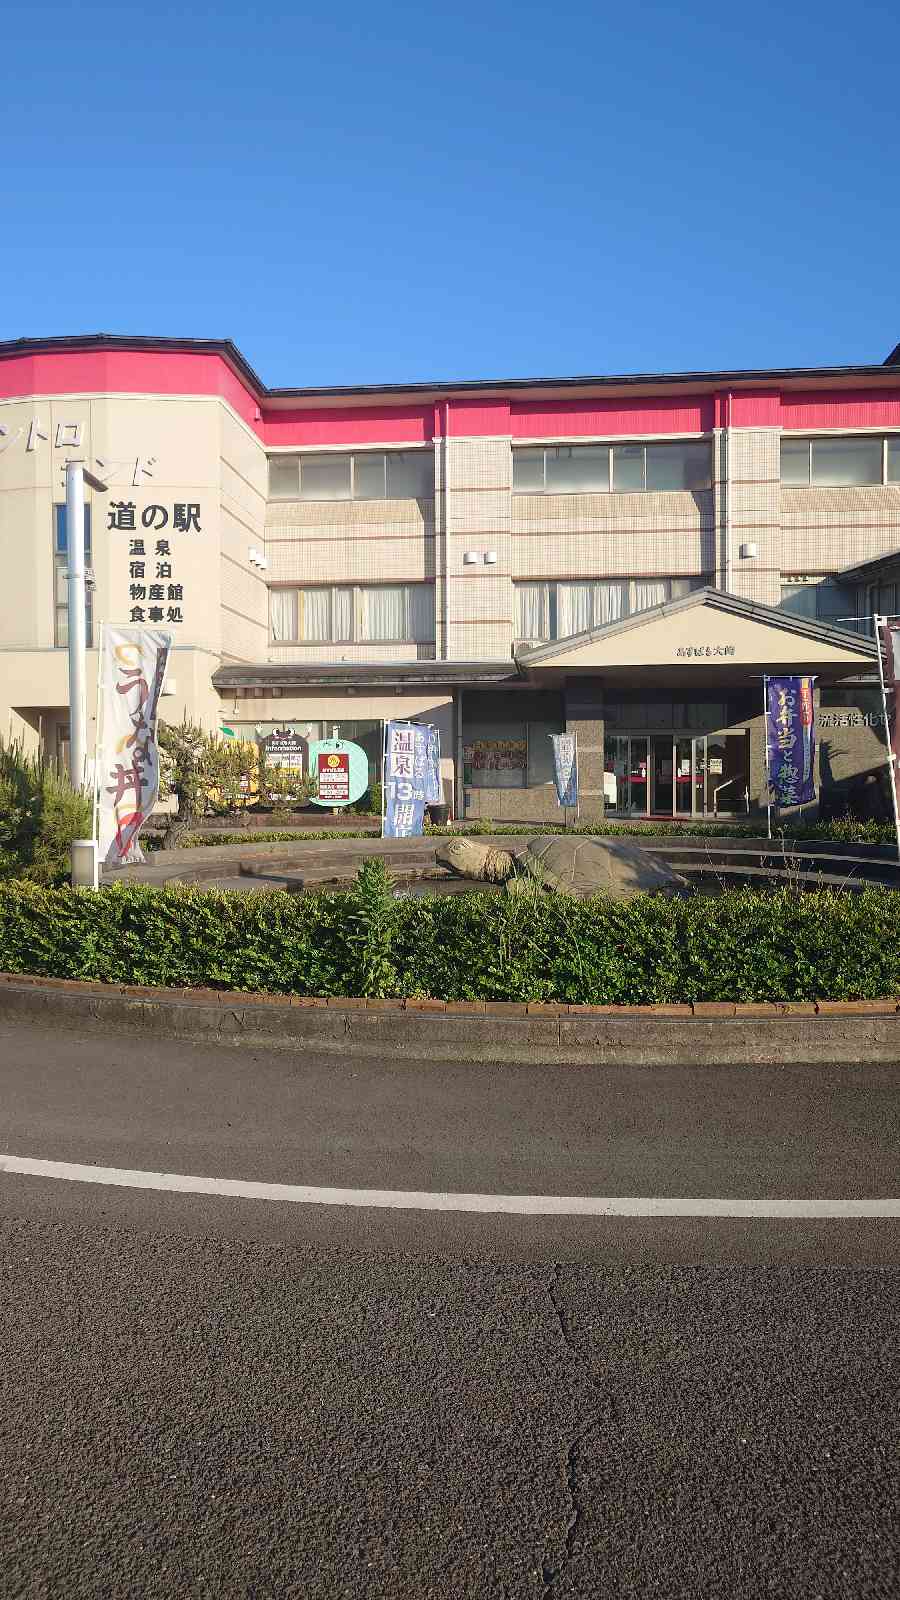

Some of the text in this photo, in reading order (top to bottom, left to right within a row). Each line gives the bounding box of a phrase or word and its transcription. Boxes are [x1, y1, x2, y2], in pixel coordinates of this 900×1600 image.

[107, 501, 202, 533] 道の駅
[129, 583, 183, 601] 物産館
[129, 606, 183, 623] 食事処
